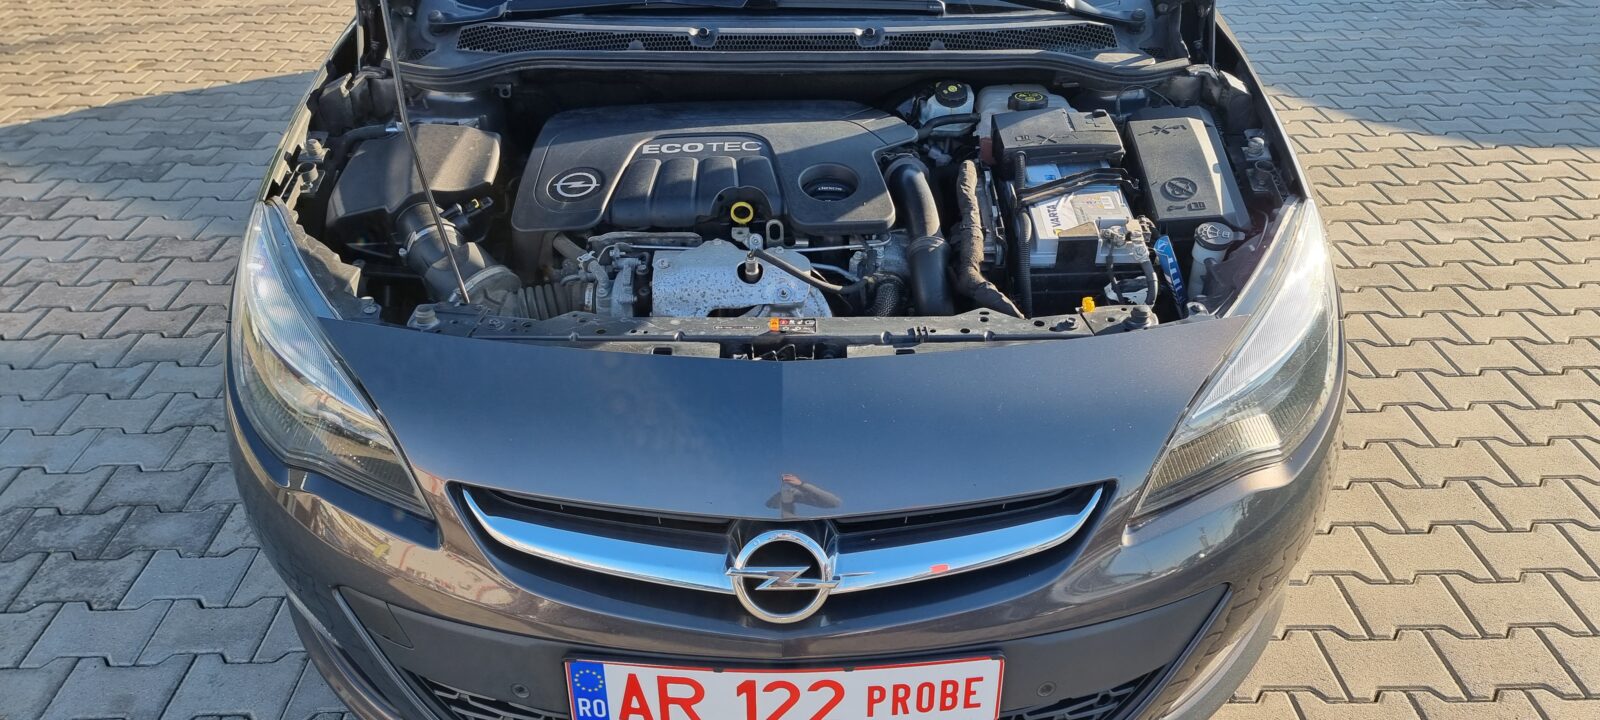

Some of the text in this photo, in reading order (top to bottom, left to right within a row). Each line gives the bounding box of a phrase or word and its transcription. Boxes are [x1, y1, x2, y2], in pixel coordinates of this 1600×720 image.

[642, 141, 762, 154] ECOTEC
[1046, 204, 1062, 228] VARTA
[577, 697, 607, 718] RO
[618, 673, 984, 720] AR 122 PROBE
